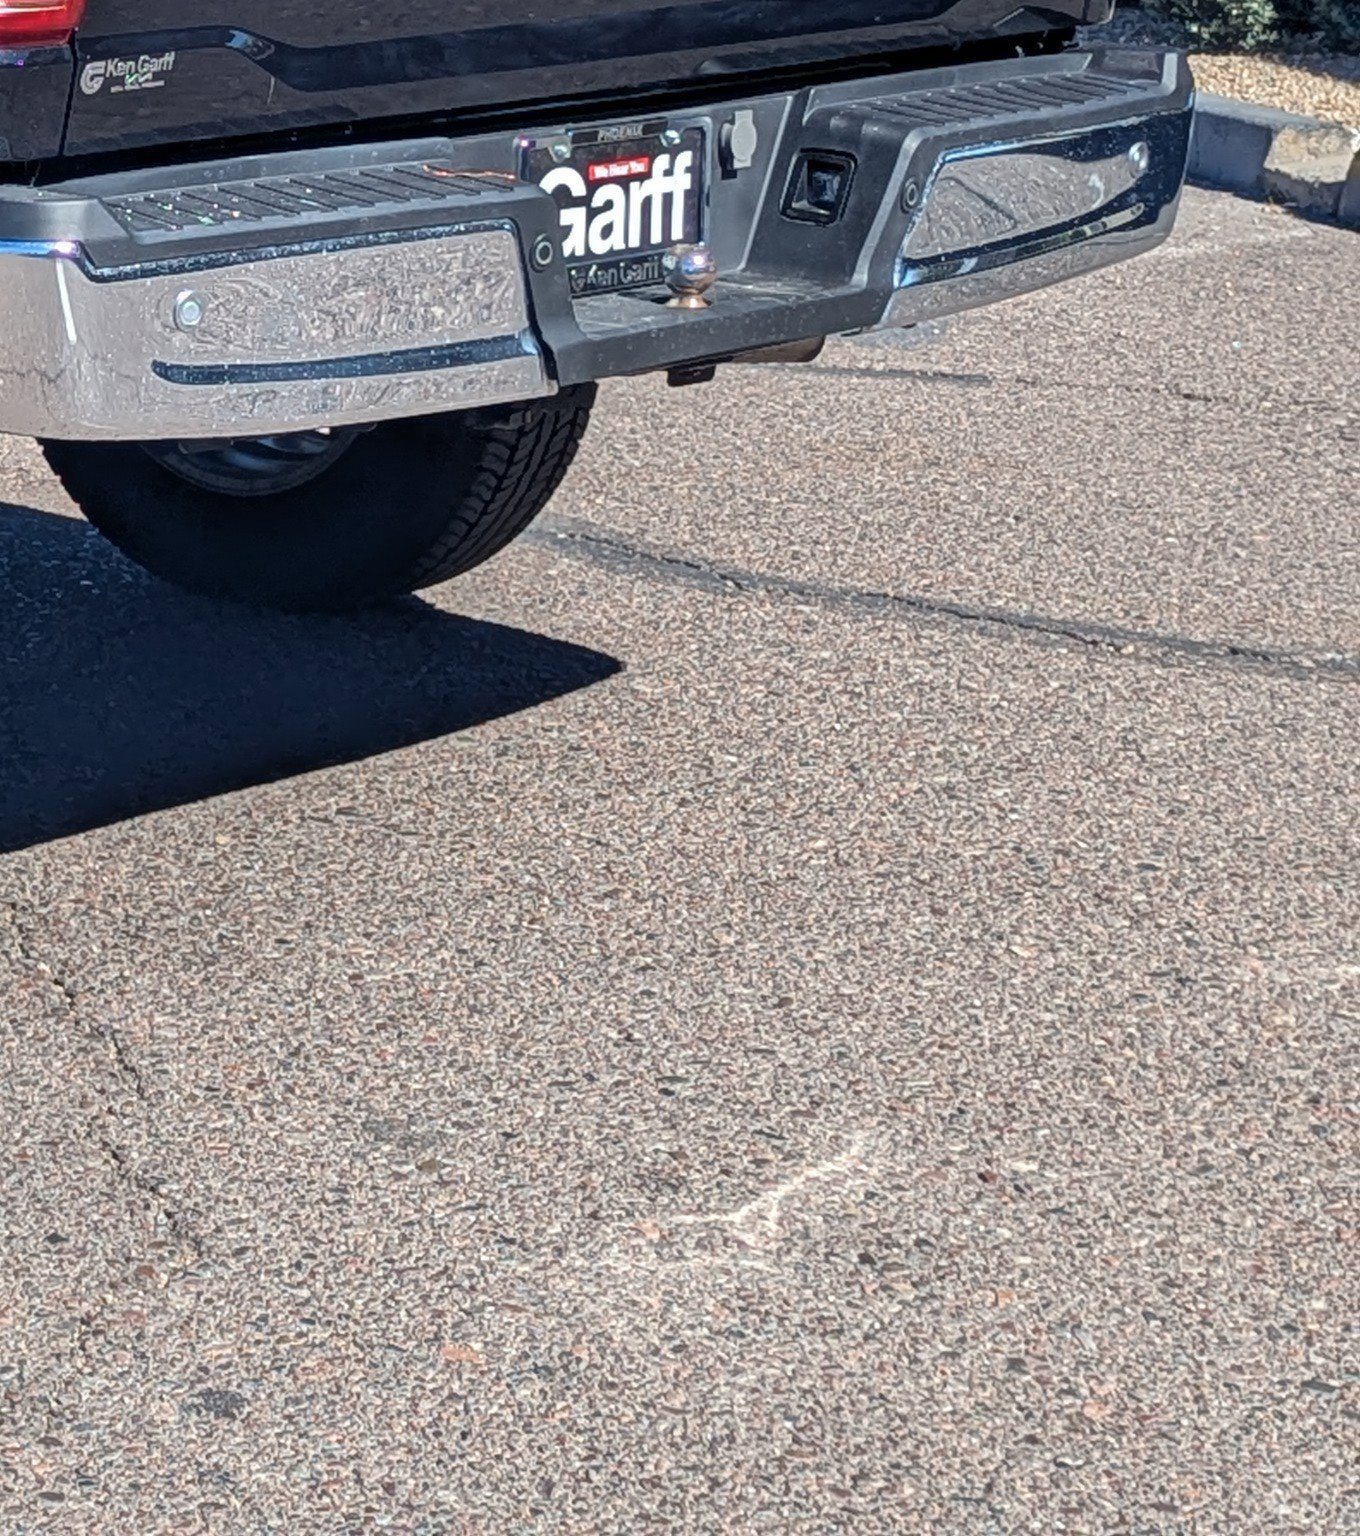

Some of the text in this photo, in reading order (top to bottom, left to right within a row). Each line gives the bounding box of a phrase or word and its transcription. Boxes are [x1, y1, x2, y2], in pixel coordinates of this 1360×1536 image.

[106, 51, 176, 77] Ken Garff
[609, 163, 629, 177] Hear
[629, 161, 645, 174] You
[540, 150, 693, 258] Garff
[587, 264, 618, 286] Ken
